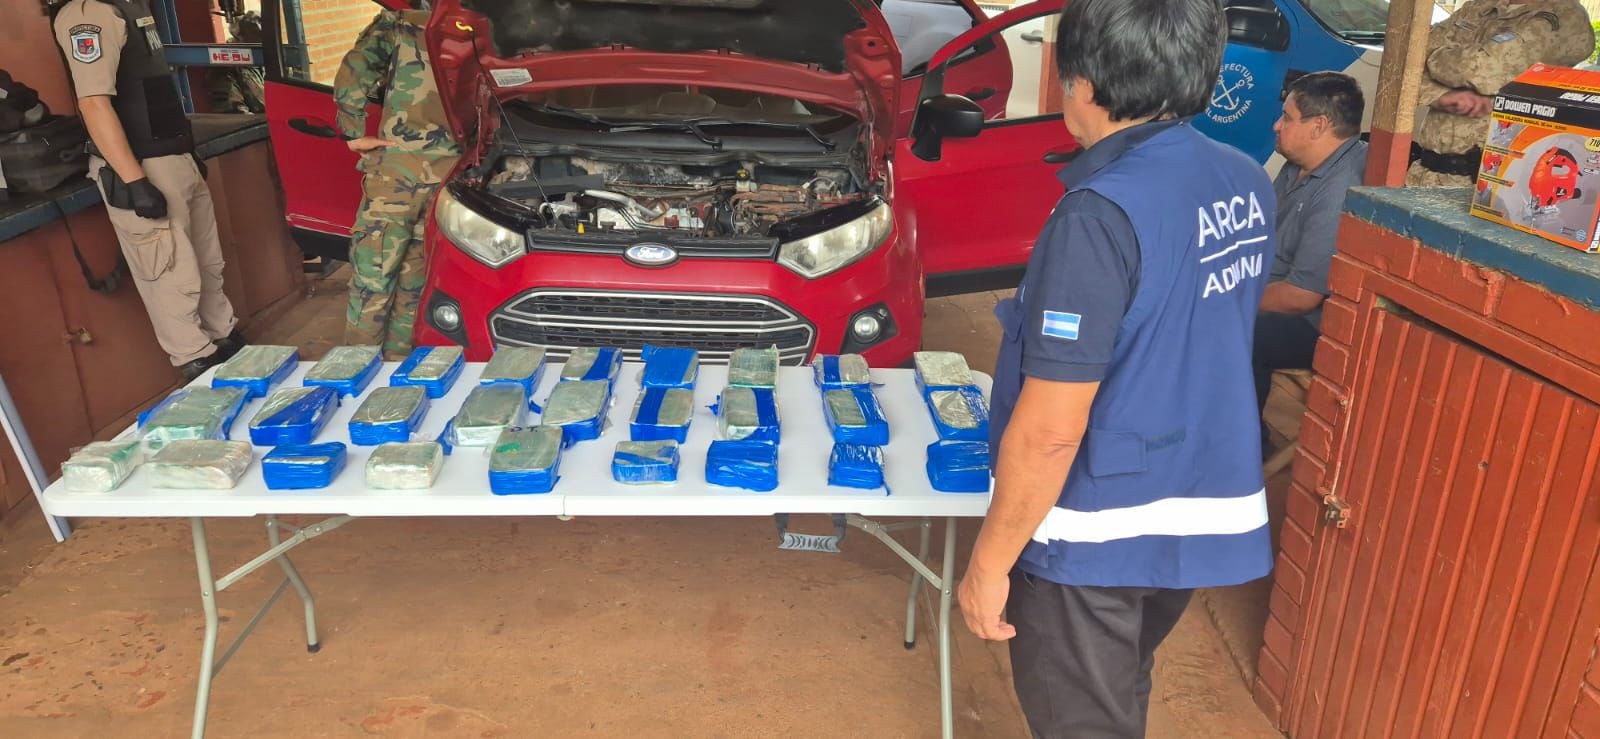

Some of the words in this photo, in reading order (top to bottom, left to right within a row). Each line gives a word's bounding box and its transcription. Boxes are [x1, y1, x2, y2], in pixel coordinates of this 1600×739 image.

[1219, 63, 1255, 90] EFECTURA
[1211, 99, 1253, 124] ARGENTINA
[1504, 99, 1532, 113] DOWEN
[1532, 104, 1556, 118] PAGIO
[1198, 191, 1266, 248] ARCA
[637, 246, 664, 259] Ford
